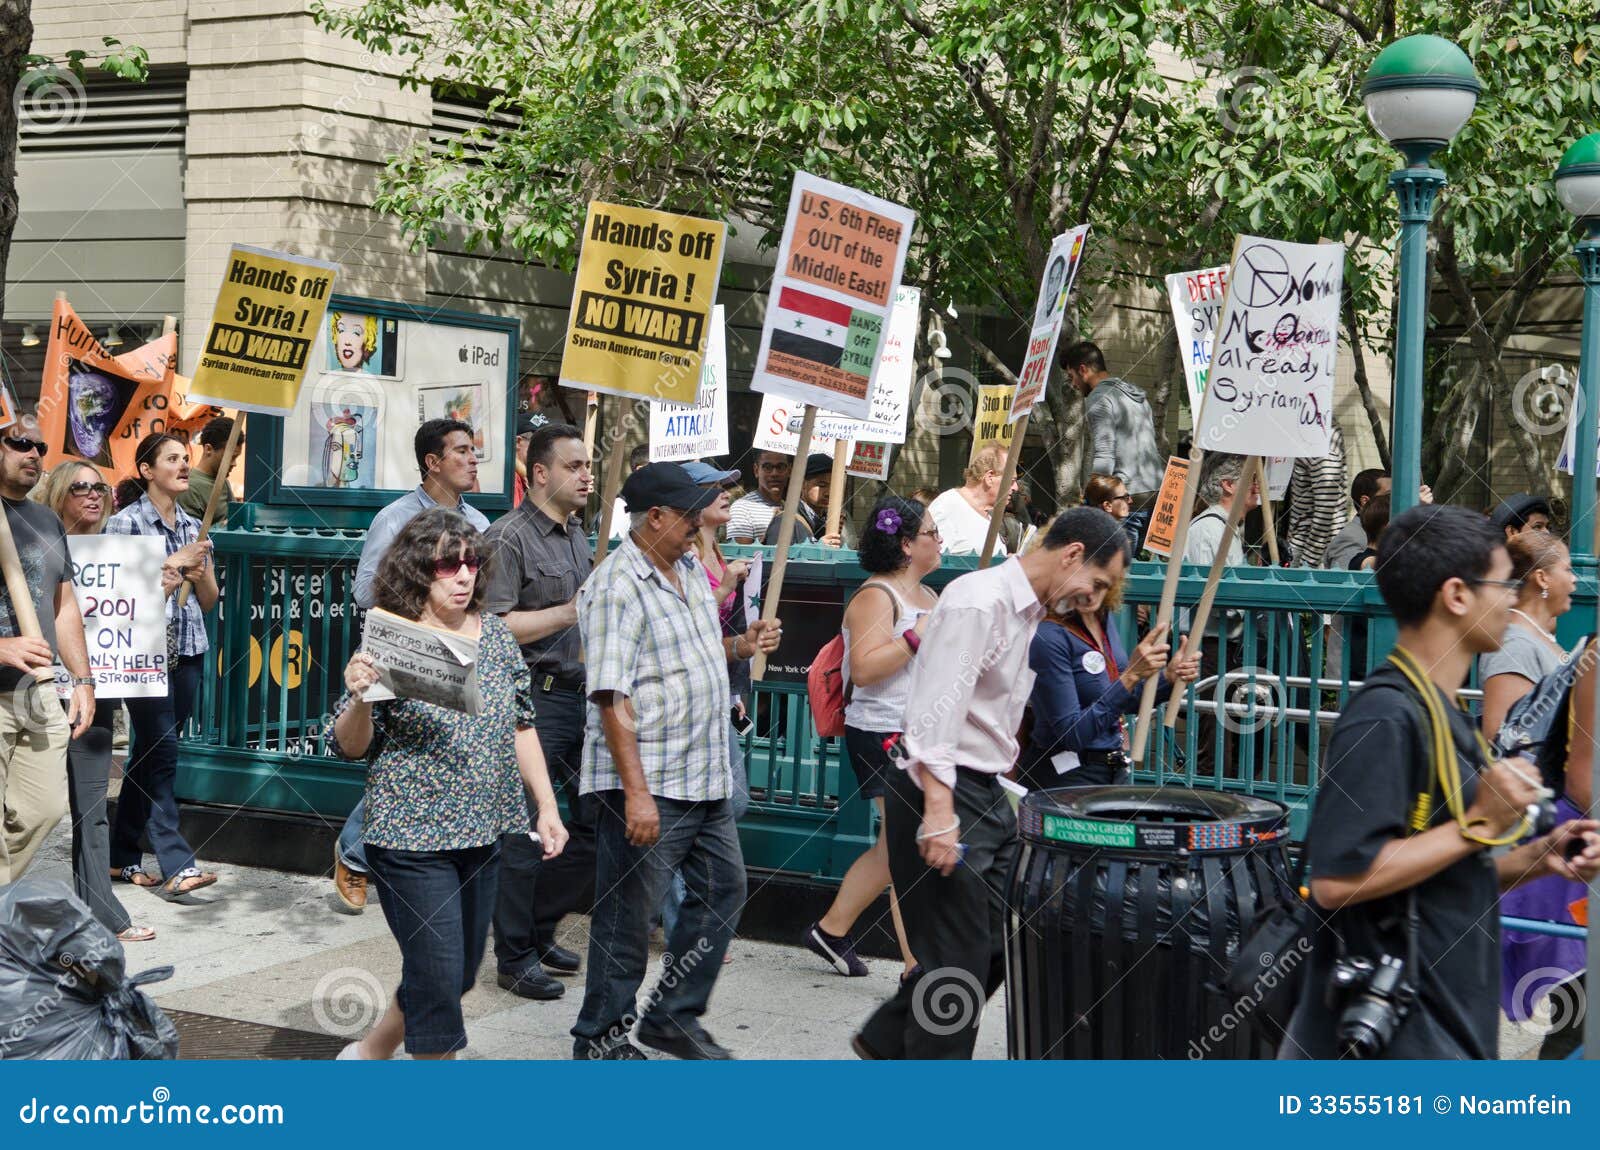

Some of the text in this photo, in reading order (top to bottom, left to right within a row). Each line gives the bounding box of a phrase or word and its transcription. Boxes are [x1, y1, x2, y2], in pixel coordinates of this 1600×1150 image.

[800, 194, 902, 245] U.S. 6th Fleet
[591, 214, 716, 261] Hands off
[809, 228, 883, 268] OUT of the
[228, 259, 329, 300] Hands off
[792, 253, 887, 300] Middle East!
[584, 297, 620, 331] NO
[851, 313, 883, 335] HANDS
[212, 327, 244, 355] NO
[572, 333, 691, 368] Syrian American Forum
[854, 338, 872, 349] OFF
[201, 357, 297, 382] Syrian American Forum
[472, 345, 500, 368] iPad
[665, 411, 714, 437] ATTACK!
[123, 654, 165, 670] HELP
[366, 644, 382, 660] No
[418, 665, 433, 677] on
[767, 663, 783, 674] New
[784, 665, 800, 674] York
[98, 672, 166, 685] STRONGER
[1099, 822, 1135, 835] GREEN
